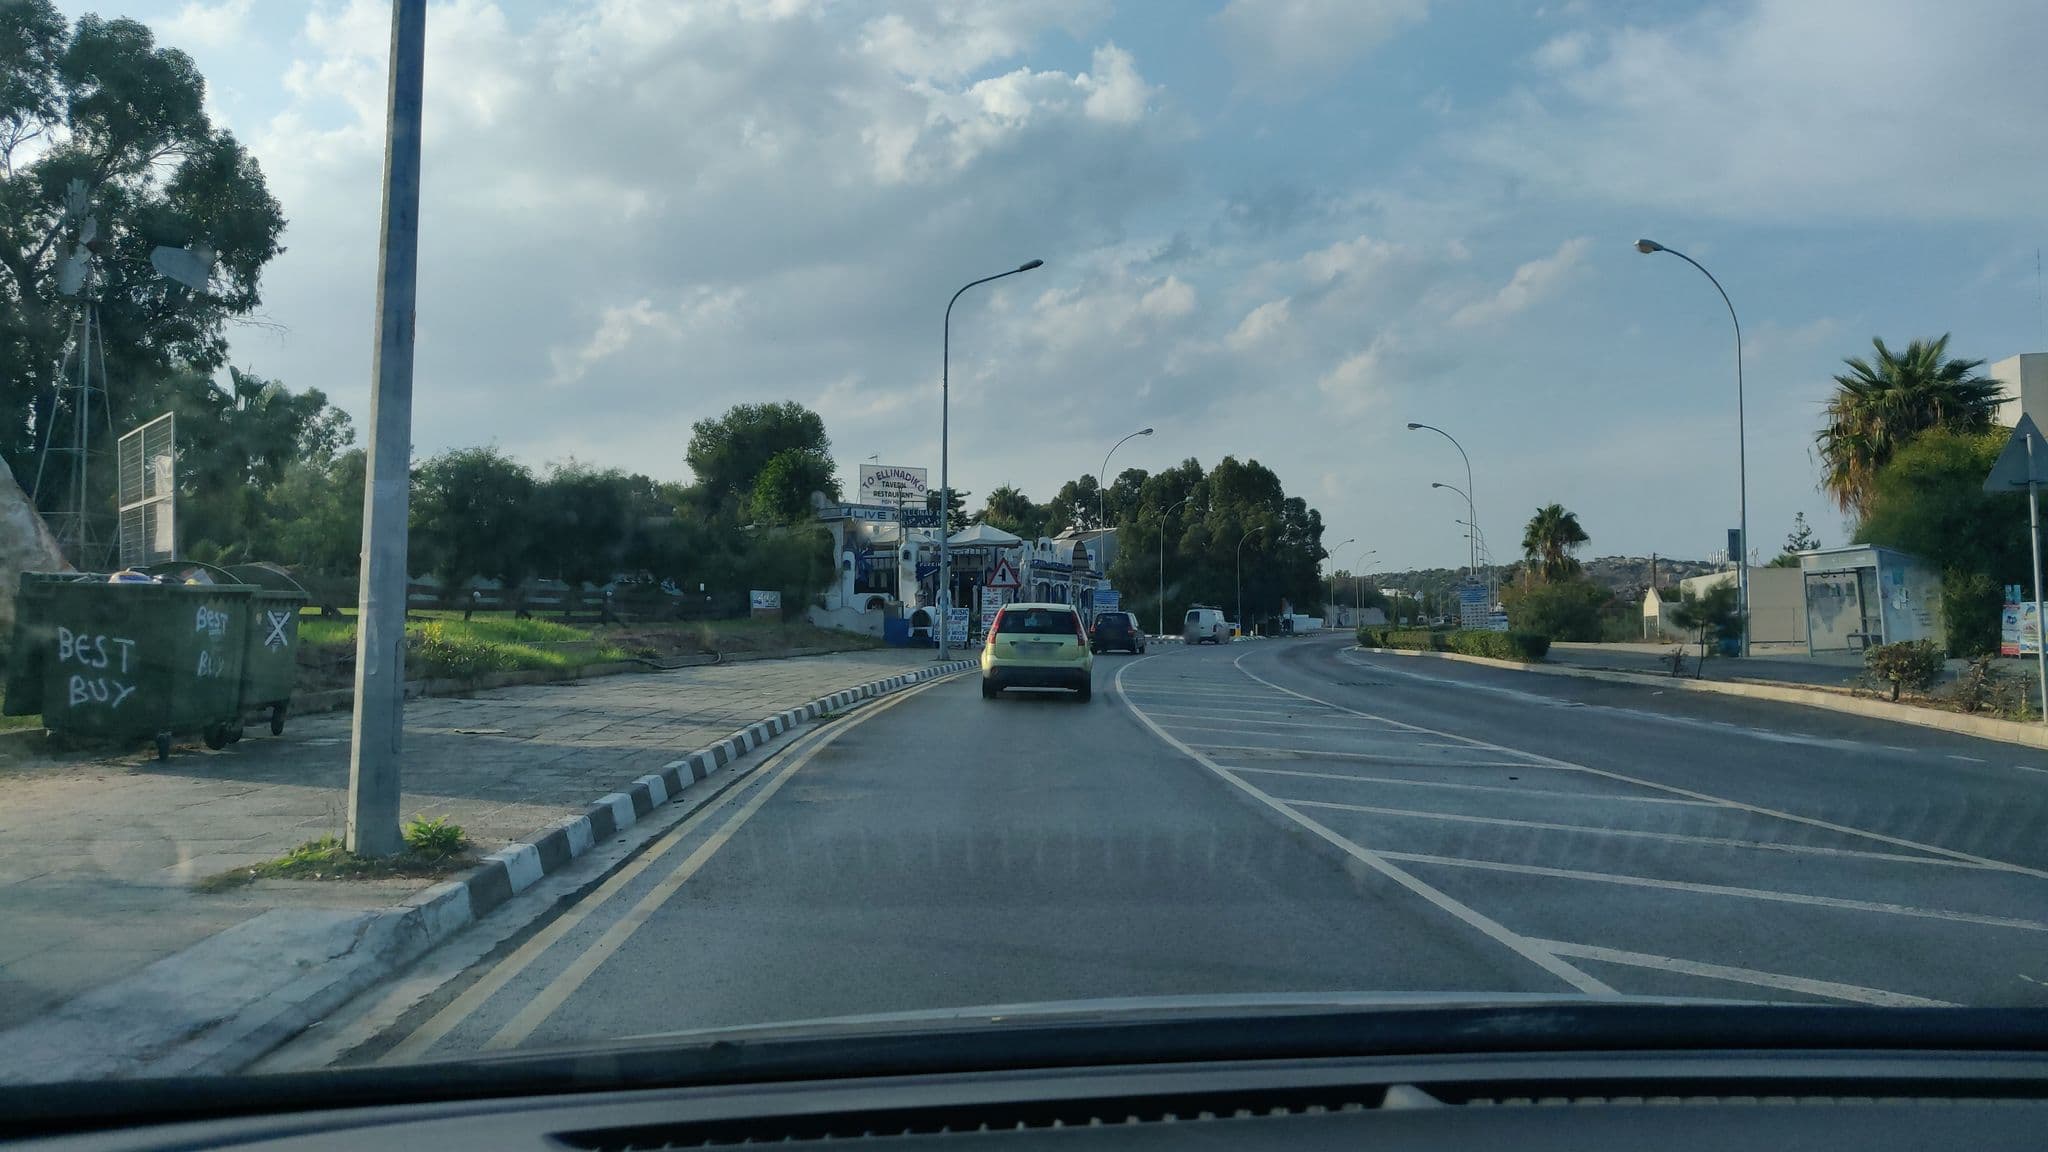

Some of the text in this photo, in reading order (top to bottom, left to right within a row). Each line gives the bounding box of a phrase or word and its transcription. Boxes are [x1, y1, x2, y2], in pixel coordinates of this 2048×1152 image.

[862, 469, 925, 493] TO ELLINADIKO
[853, 509, 887, 520] LIVE
[58, 626, 136, 674] BEST
[69, 675, 137, 708] BUY
